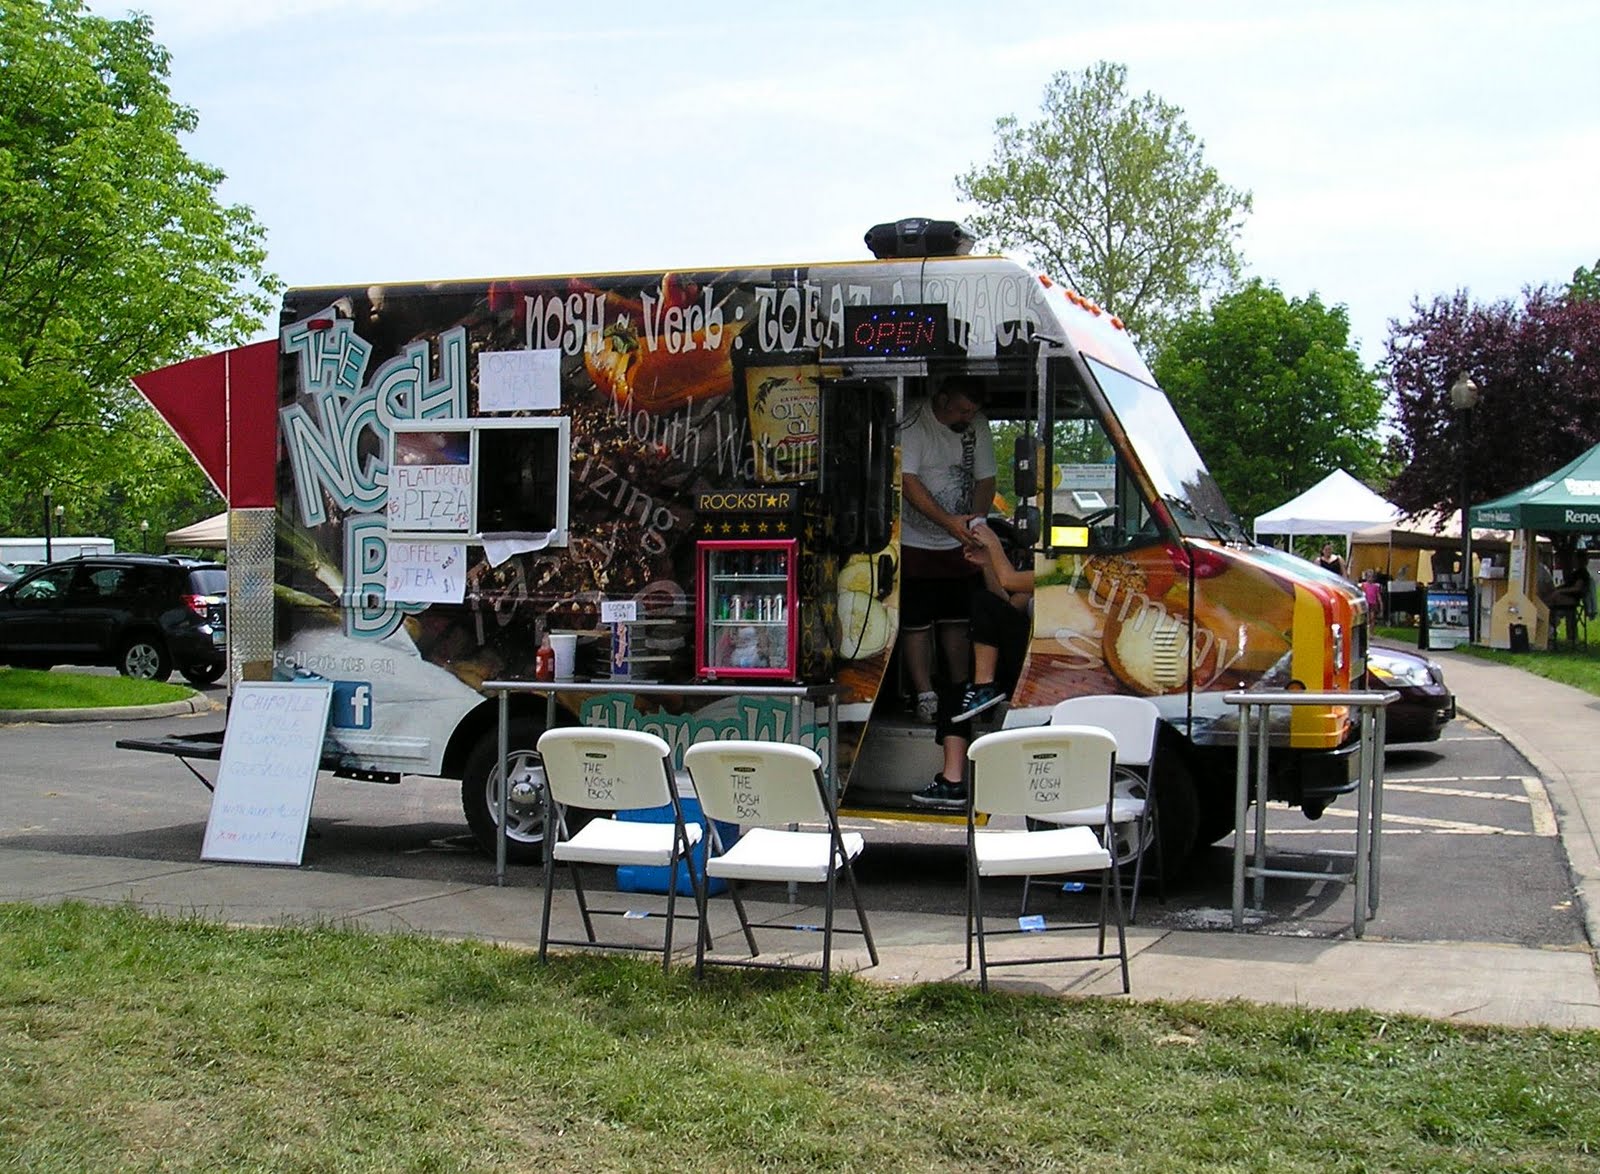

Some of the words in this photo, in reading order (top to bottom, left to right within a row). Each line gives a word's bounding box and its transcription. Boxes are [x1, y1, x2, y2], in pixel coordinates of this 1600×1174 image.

[853, 321, 937, 347] OPEN
[289, 318, 367, 391] THE
[606, 384, 701, 468] Mouth
[403, 488, 470, 522] PIZZA
[390, 544, 441, 564] COFFEE
[401, 567, 437, 588] TEA
[341, 656, 366, 673] us
[370, 658, 396, 675] on
[583, 762, 603, 775] THE
[1026, 761, 1054, 775] THE
[584, 776, 614, 789] NOSH
[730, 774, 752, 790] THE
[1029, 776, 1061, 791] NOSH
[587, 788, 615, 801] BOX
[733, 792, 760, 806] NOSH
[1034, 791, 1060, 803] BOX
[736, 805, 761, 819] BOX
